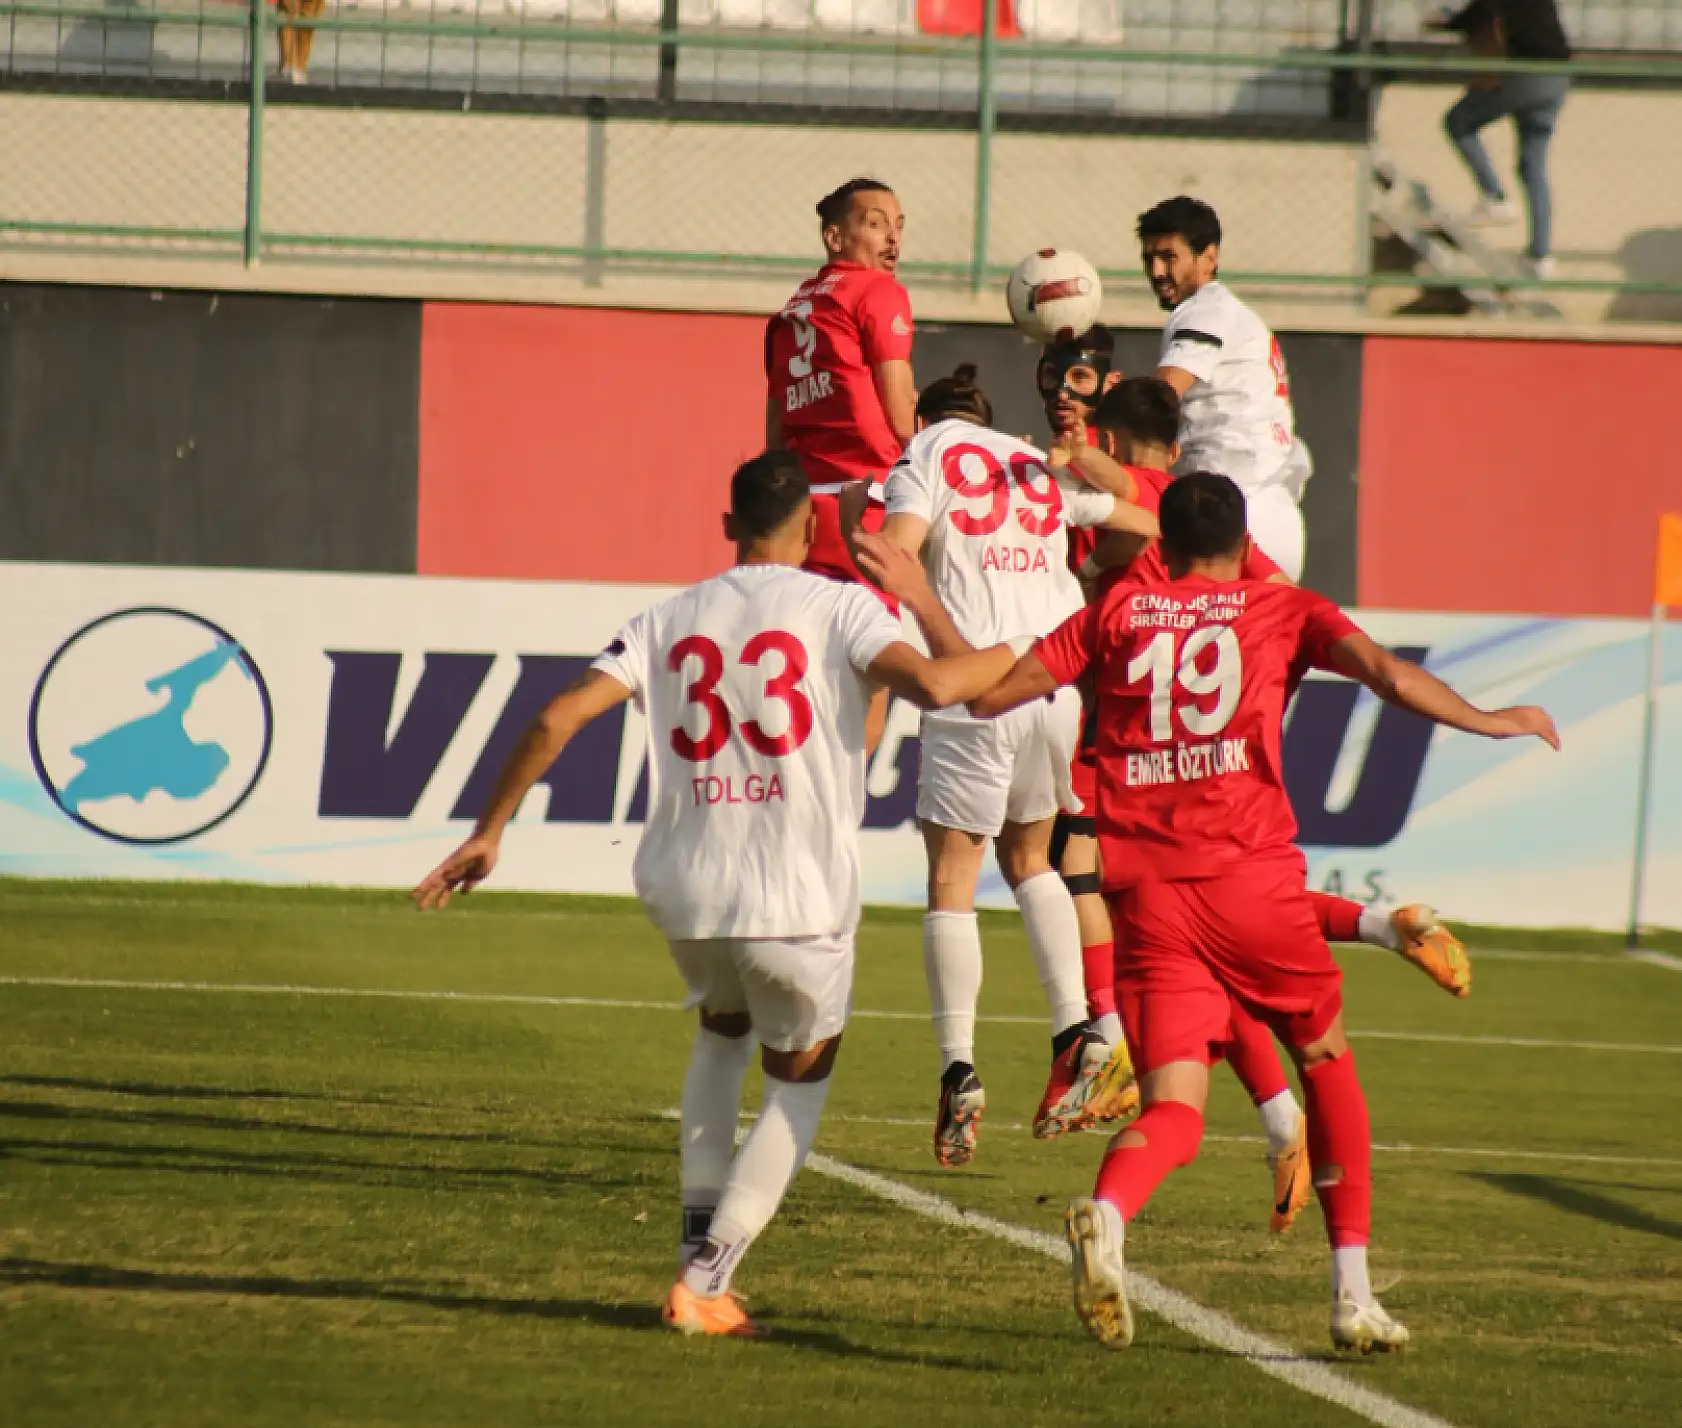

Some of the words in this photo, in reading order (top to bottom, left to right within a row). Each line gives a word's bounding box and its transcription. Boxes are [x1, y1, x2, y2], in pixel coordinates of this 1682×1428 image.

[941, 442, 1063, 537] 99
[983, 547, 1050, 573] ARDA
[667, 630, 813, 763] 33
[1127, 625, 1243, 742] 19
[692, 773, 784, 806] TOLGA
[1126, 749, 1176, 787] EMRE
